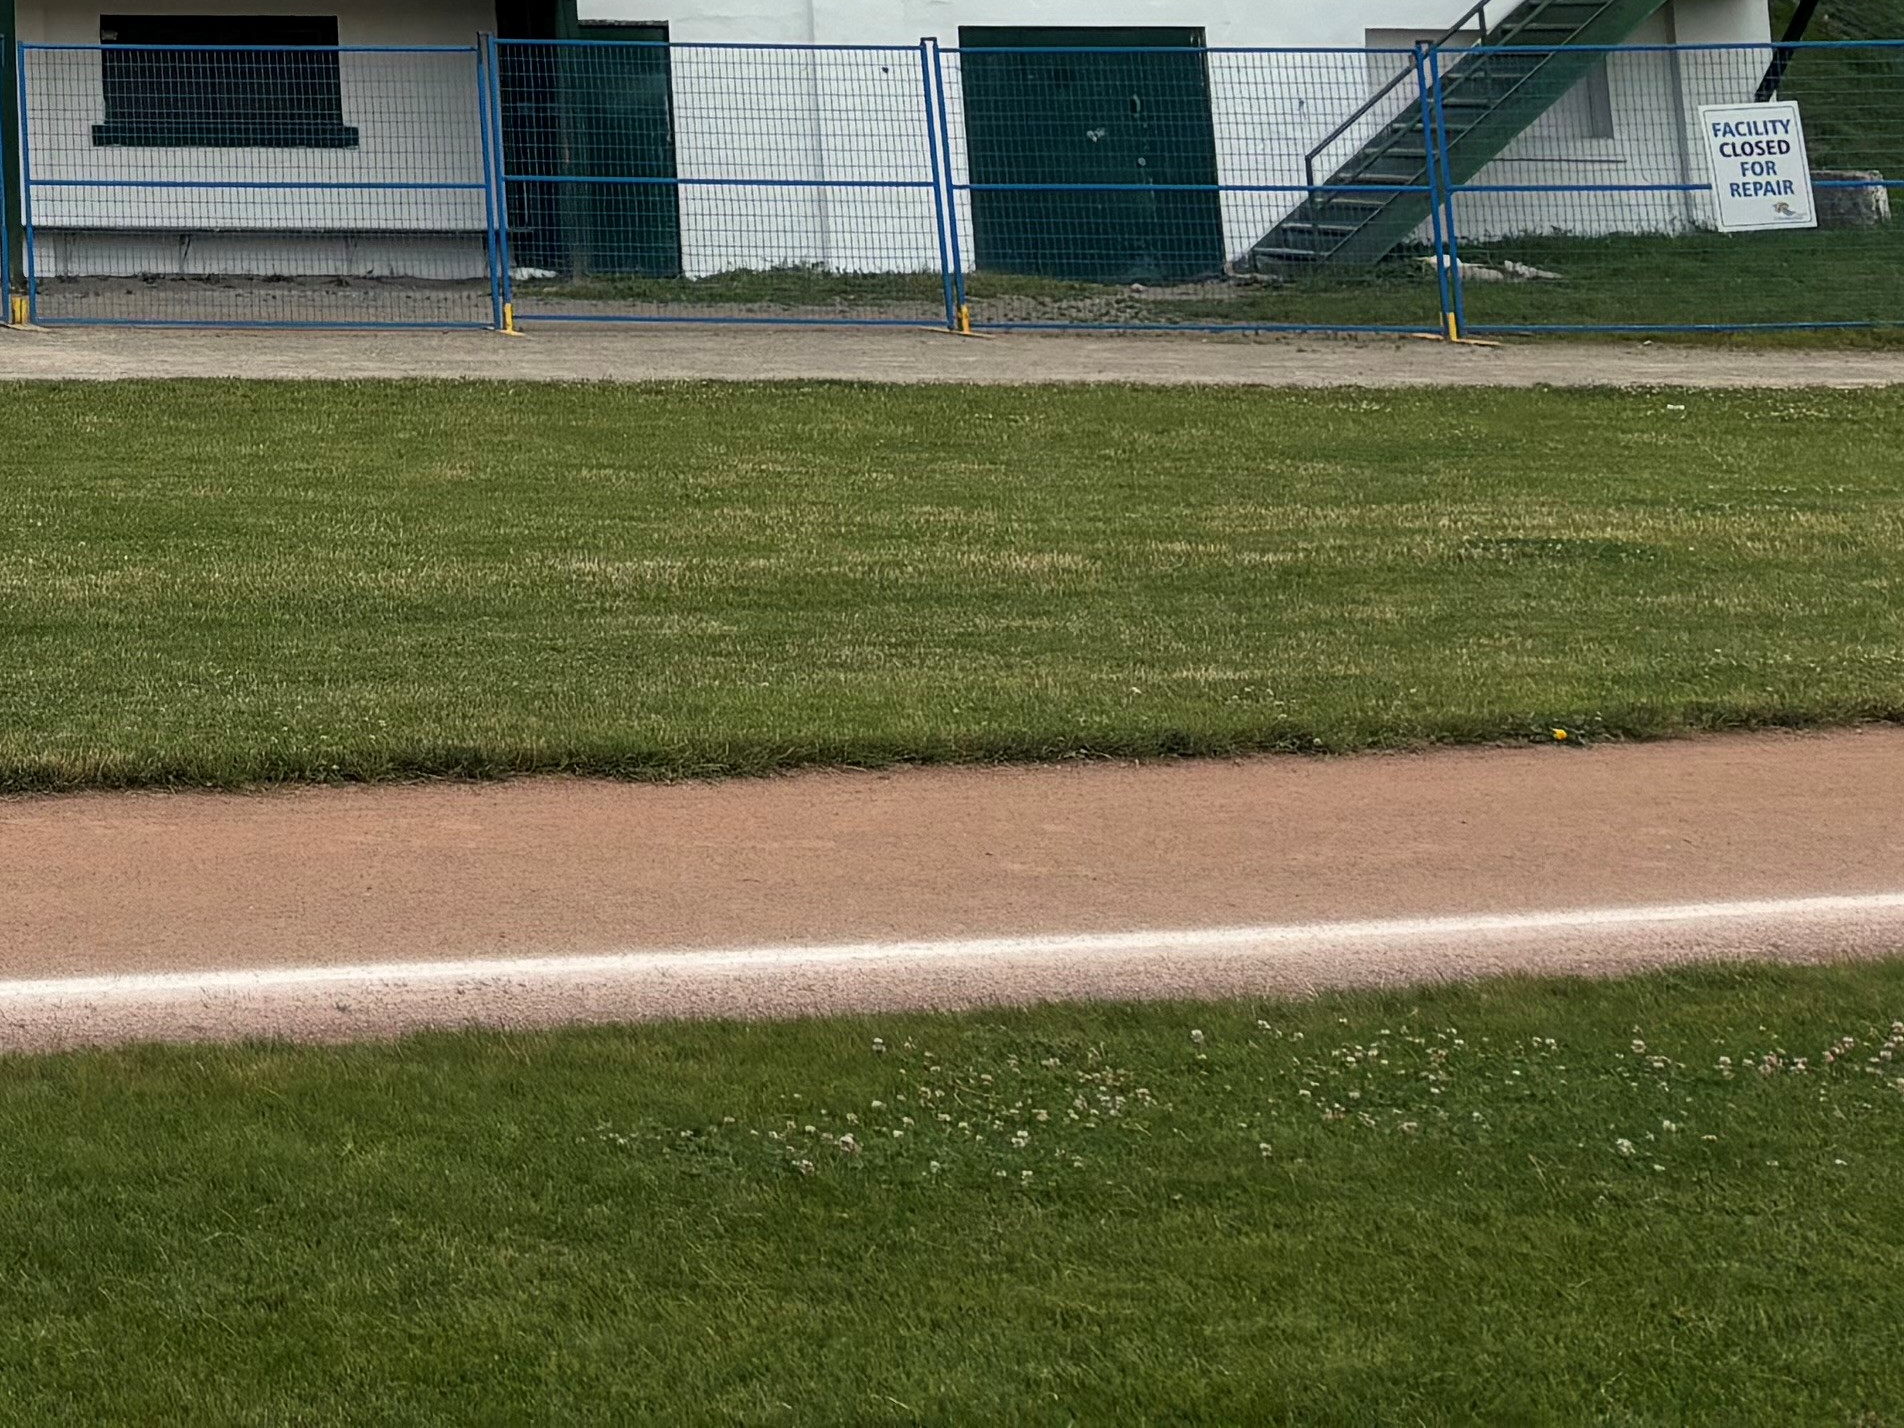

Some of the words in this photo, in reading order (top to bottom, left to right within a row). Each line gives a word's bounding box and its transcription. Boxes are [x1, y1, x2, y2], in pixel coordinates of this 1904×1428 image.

[1711, 119, 1791, 138] FACILITY
[1719, 139, 1791, 158] CLOSED
[1740, 160, 1777, 177] FOR
[1729, 179, 1794, 198] REPAIR
